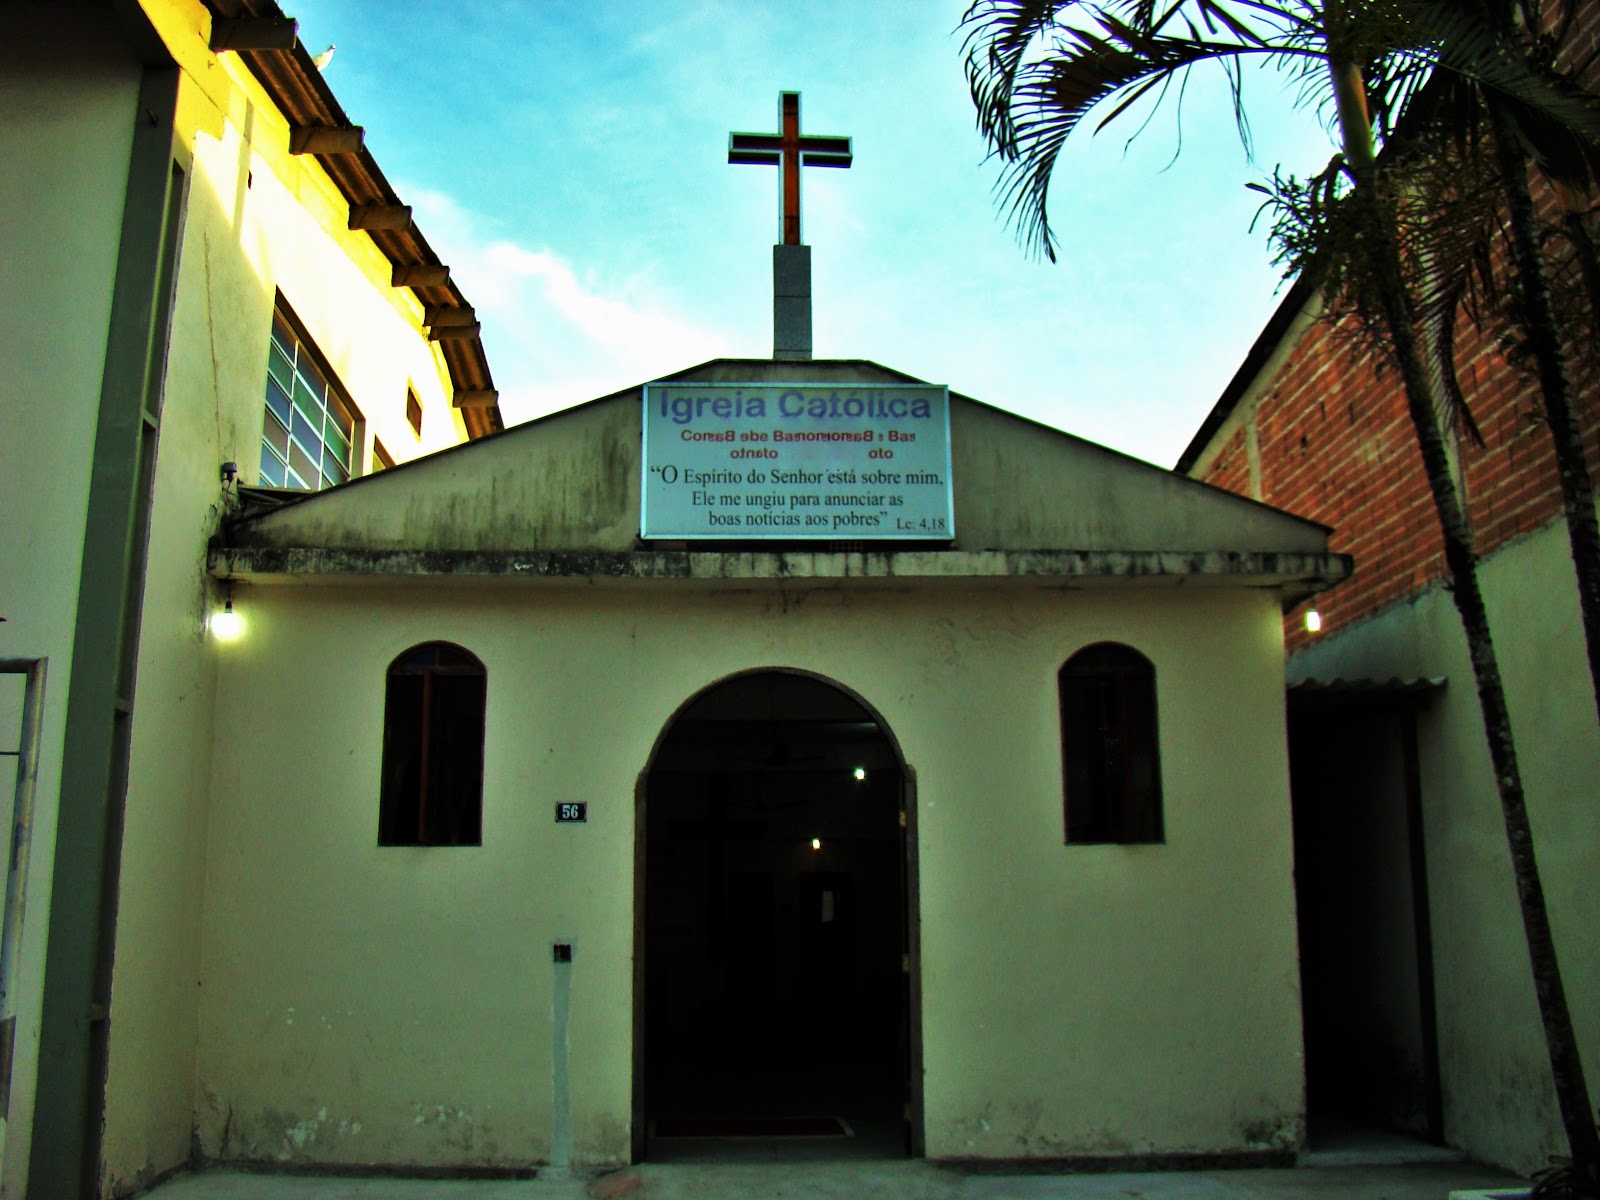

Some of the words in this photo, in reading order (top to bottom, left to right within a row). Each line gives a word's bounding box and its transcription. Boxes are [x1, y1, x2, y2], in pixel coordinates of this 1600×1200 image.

[778, 390, 931, 419] Católica
[684, 468, 742, 488] Espírito
[747, 468, 766, 484] do
[770, 469, 823, 485] Senhor
[827, 469, 857, 485] está
[861, 469, 901, 485] sobre
[692, 490, 715, 506] Ele
[719, 494, 741, 506] me
[745, 491, 786, 510] ungiu
[789, 494, 820, 510] para
[824, 490, 885, 507] anunciar
[889, 495, 904, 507] as
[708, 510, 741, 526] boas
[745, 510, 801, 526] notícias
[804, 515, 829, 526] aos
[562, 804, 579, 819] 56
